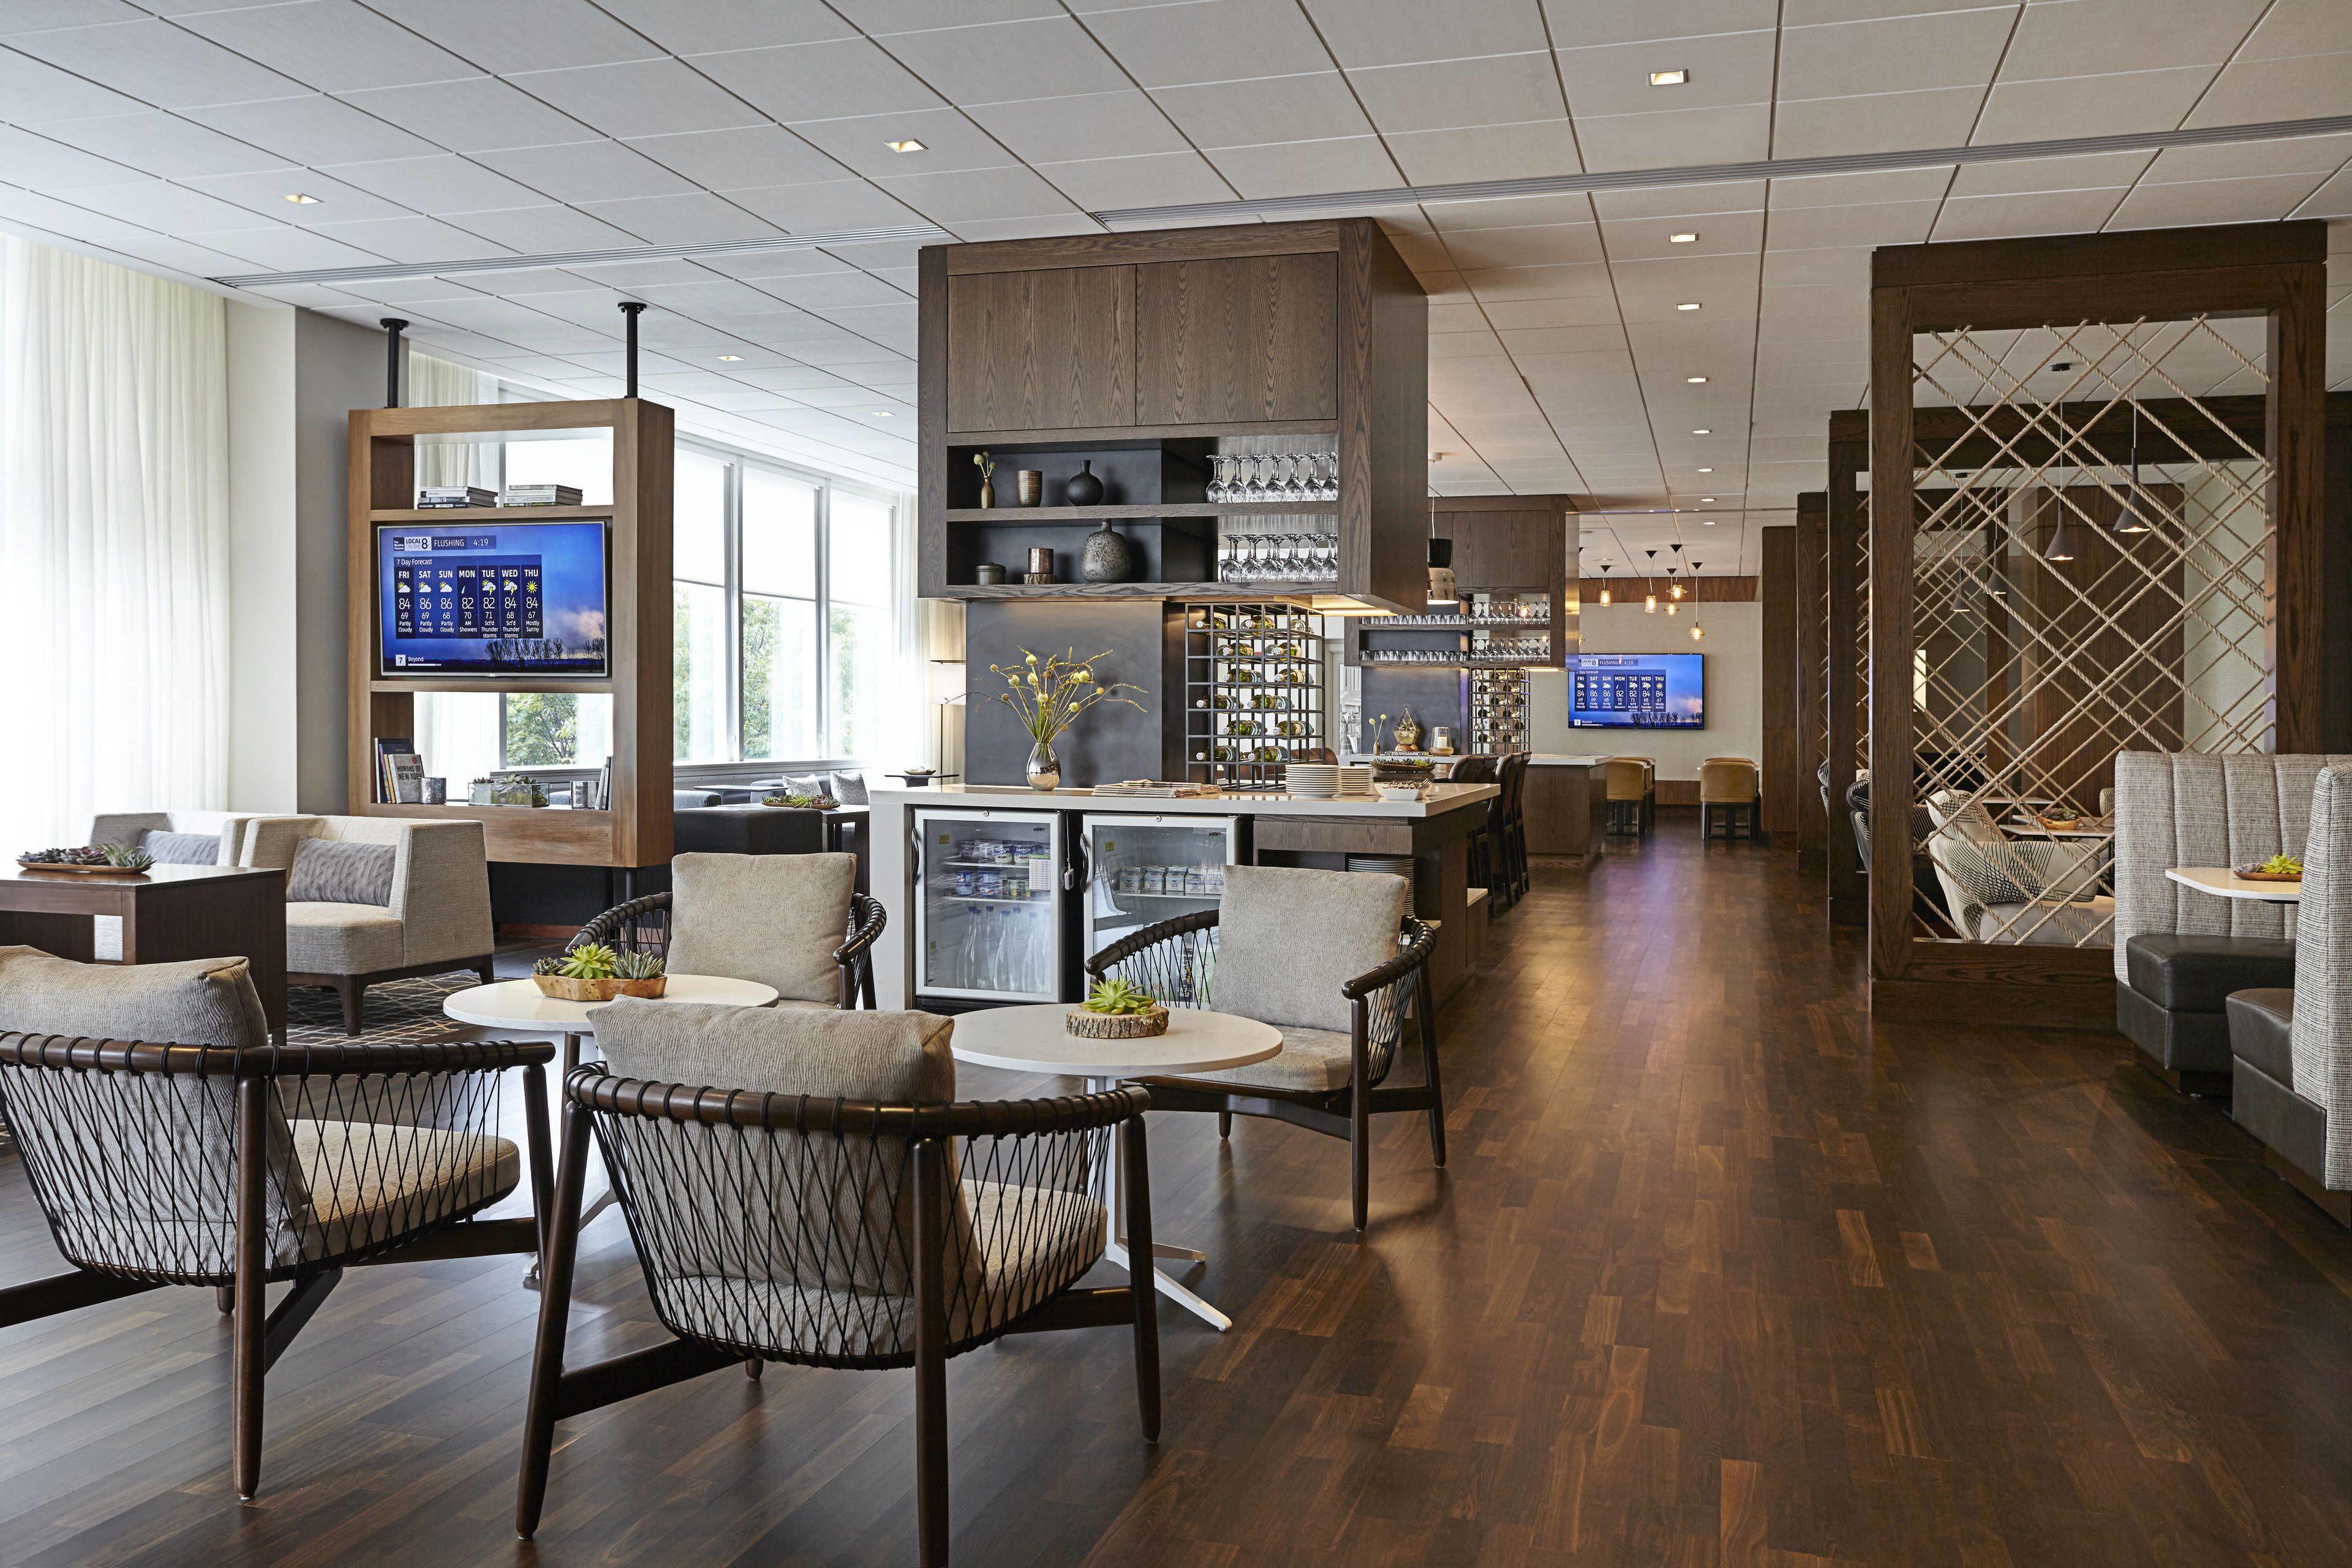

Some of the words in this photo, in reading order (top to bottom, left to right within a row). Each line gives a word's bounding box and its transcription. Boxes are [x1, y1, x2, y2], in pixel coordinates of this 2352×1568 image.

[399, 598, 410, 609] 84
[420, 598, 431, 609] 86
[440, 598, 452, 609] 86
[462, 598, 474, 609] 82
[483, 597, 496, 609] 82
[505, 597, 516, 609] 84
[526, 597, 538, 608] 84
